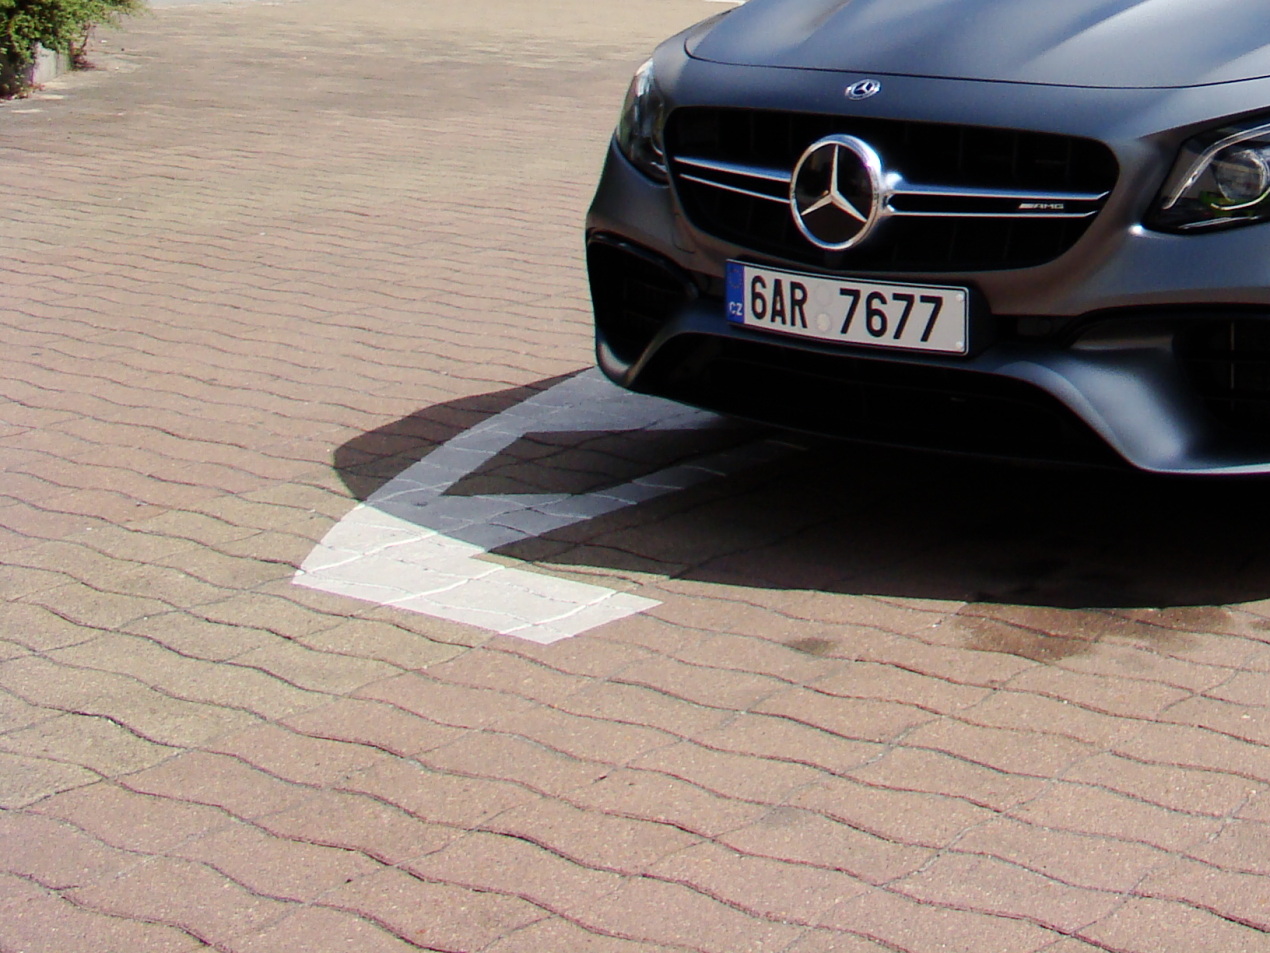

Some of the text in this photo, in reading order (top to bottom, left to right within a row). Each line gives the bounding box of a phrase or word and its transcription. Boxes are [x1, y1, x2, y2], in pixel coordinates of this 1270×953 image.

[729, 301, 743, 316] CZ
[750, 275, 944, 342] 6AR 7677
